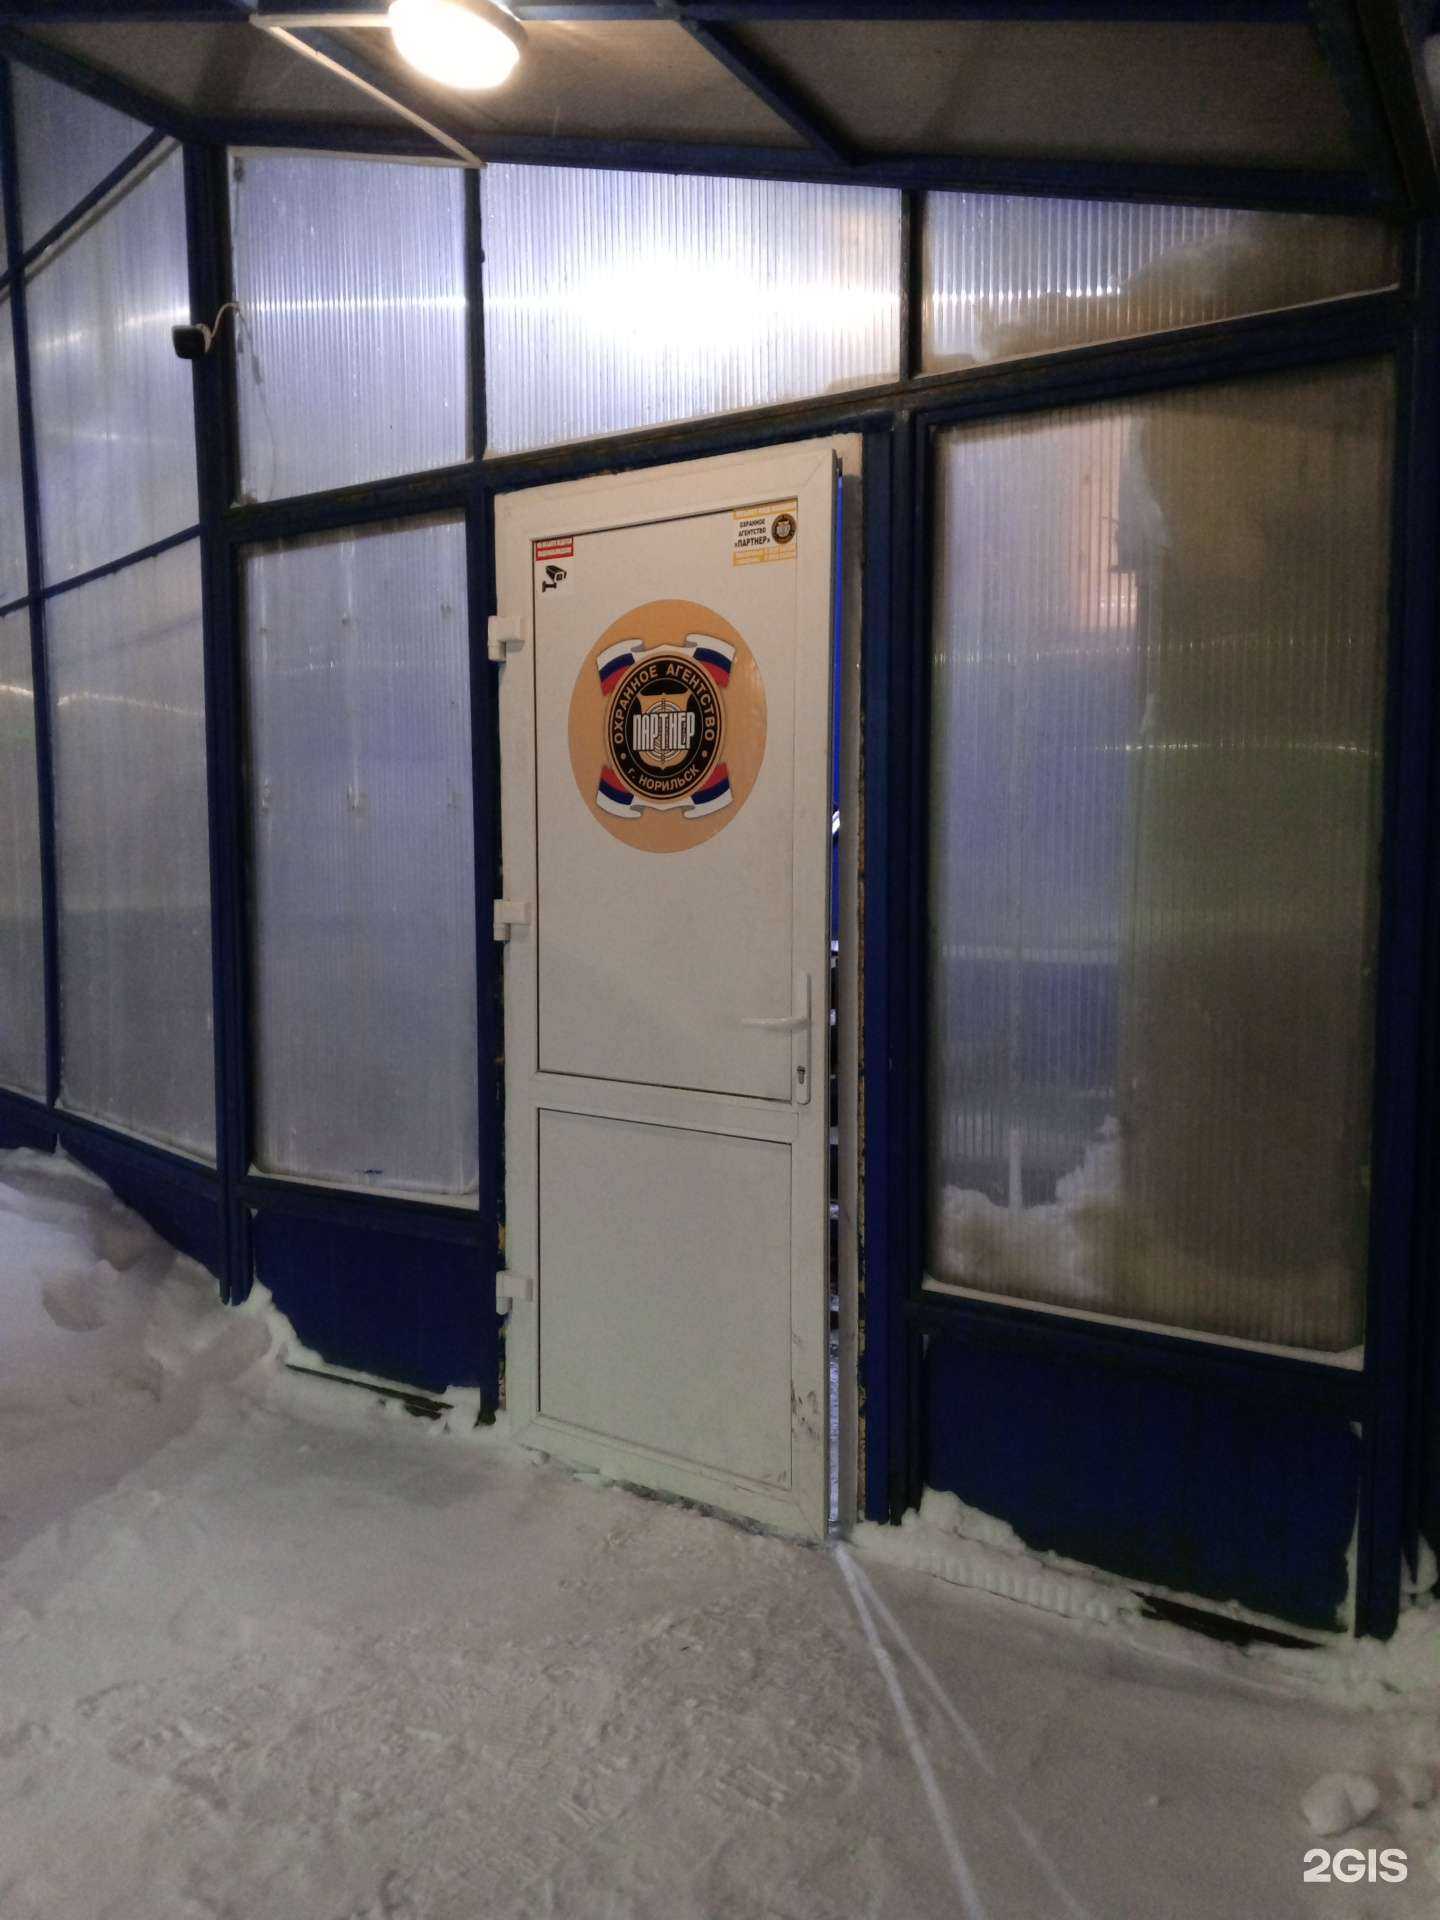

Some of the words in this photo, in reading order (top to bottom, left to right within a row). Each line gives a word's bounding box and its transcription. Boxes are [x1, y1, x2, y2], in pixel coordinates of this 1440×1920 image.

[613, 664, 658, 744] ОХРАННОЕ
[666, 663, 716, 741] АГЕНТСТВО
[632, 711, 696, 751] ПАРТНЕР
[638, 763, 700, 792] НОРИЛЬСК
